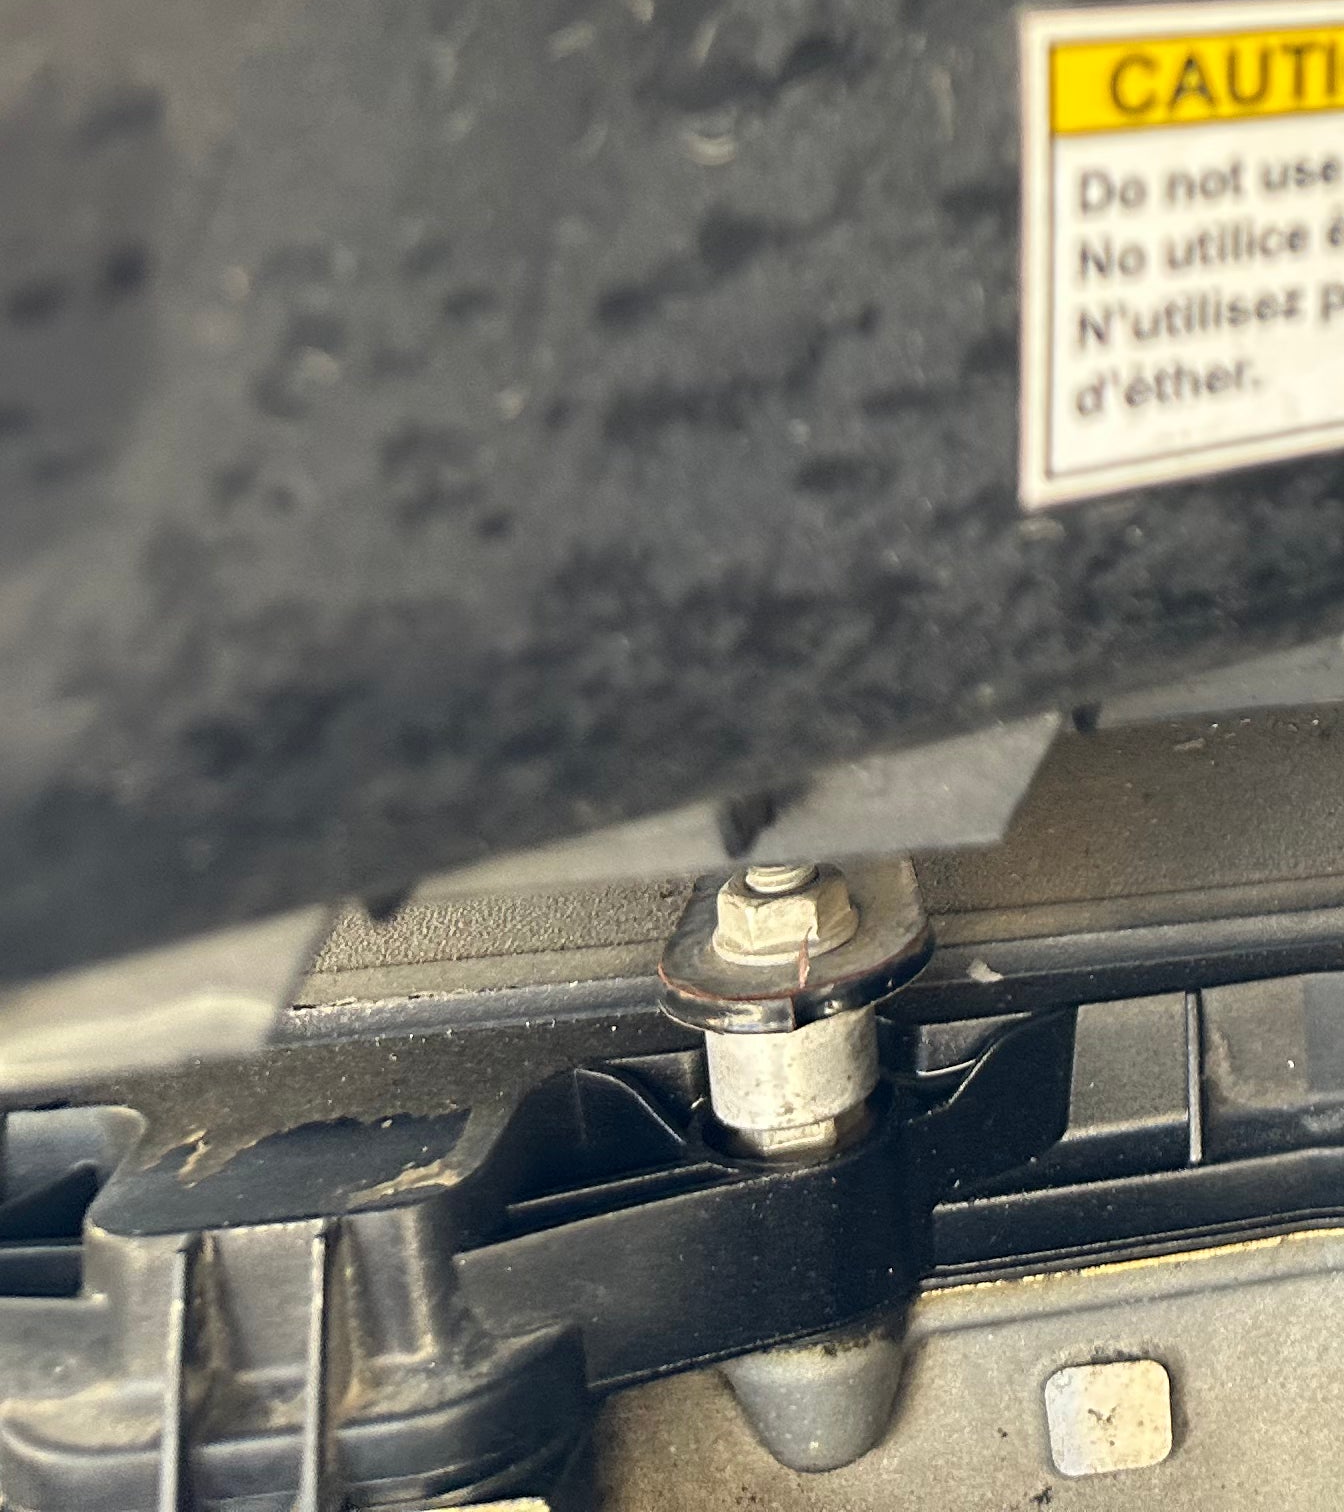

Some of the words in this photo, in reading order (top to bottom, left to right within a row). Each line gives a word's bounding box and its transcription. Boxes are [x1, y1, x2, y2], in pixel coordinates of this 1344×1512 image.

[1079, 165, 1147, 216] Do
[1166, 158, 1244, 207] not
[1260, 151, 1343, 192] use
[1078, 234, 1147, 280] No
[1166, 216, 1311, 272] utilice
[1077, 285, 1306, 350] N'utilisez
